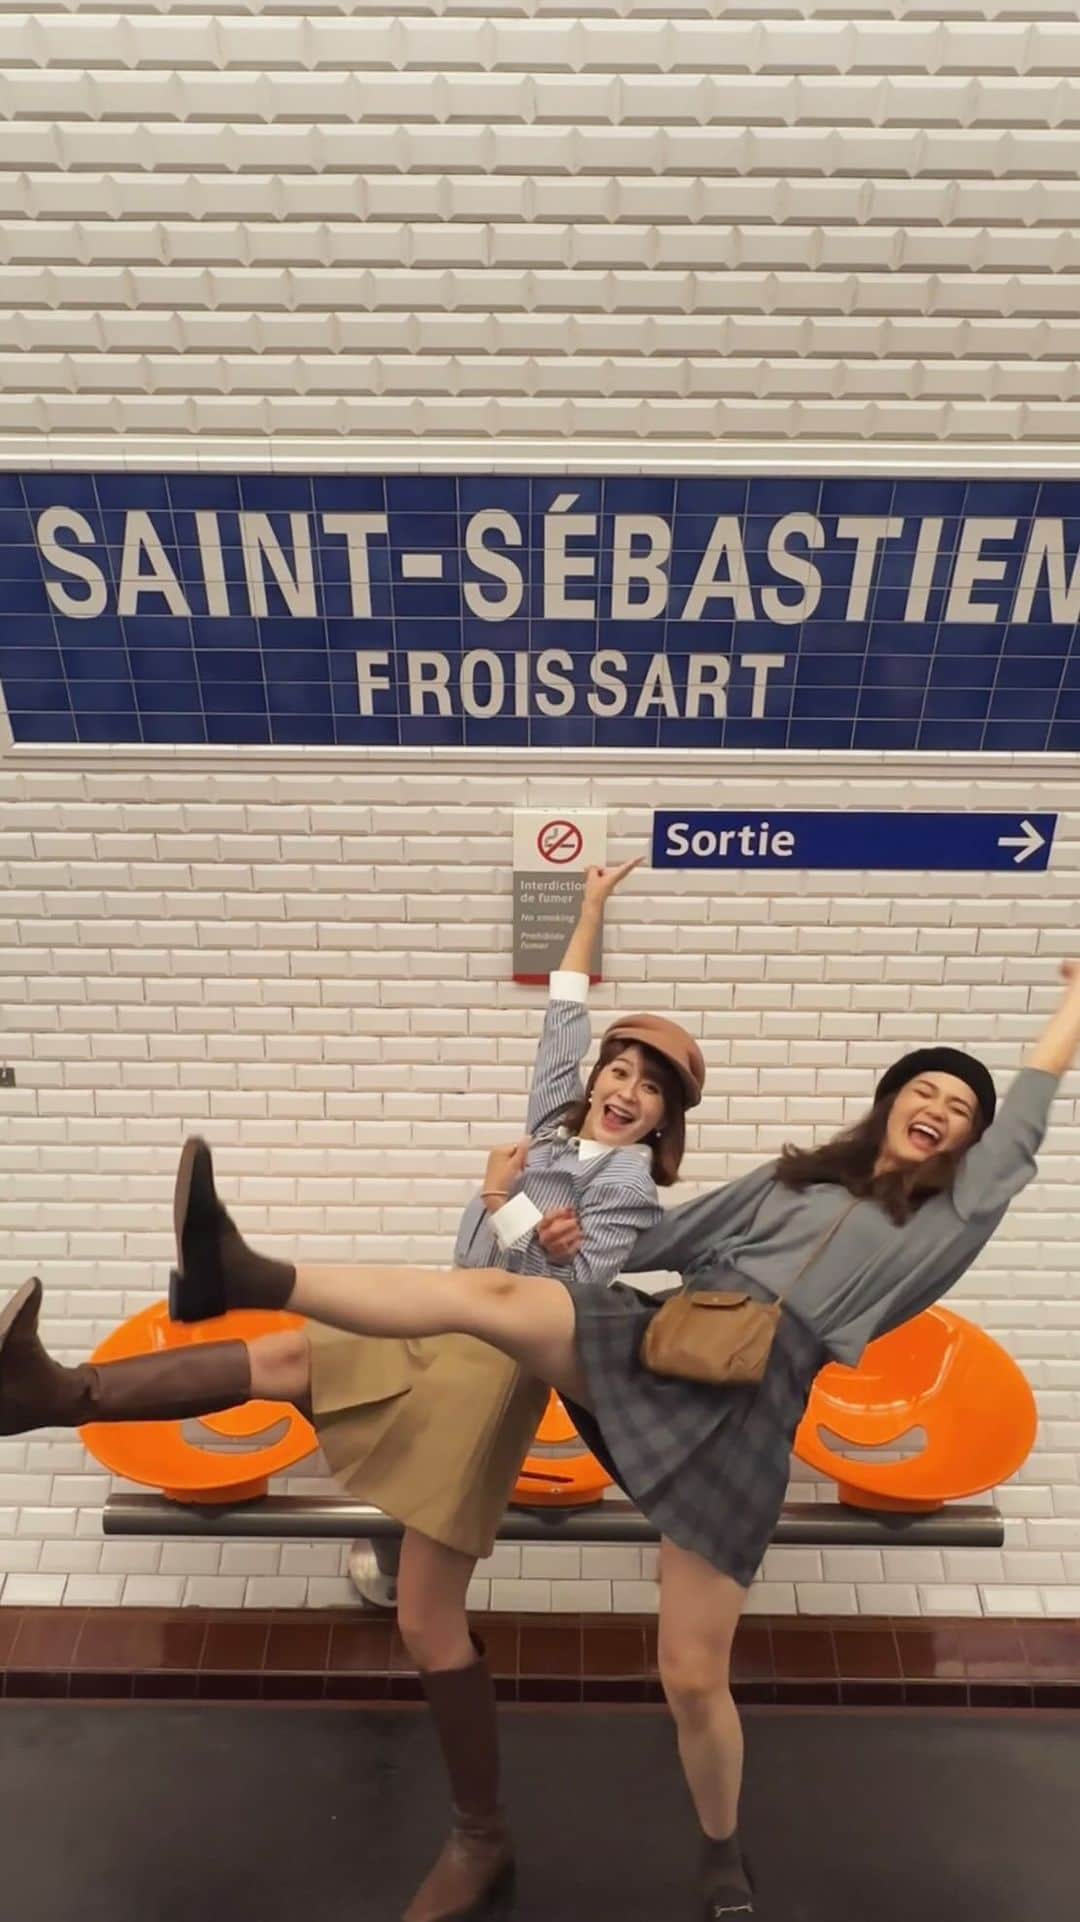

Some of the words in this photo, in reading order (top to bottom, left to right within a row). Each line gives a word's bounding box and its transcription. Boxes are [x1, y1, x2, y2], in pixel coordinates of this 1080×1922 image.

[36, 494, 1080, 624] SAINT-SÉBASTIEN
[355, 649, 784, 718] FROISSART
[666, 822, 795, 856] Sortie
[520, 893, 535, 903] de
[538, 893, 573, 903] fumer
[520, 913, 534, 921] No
[536, 912, 575, 924] smoking
